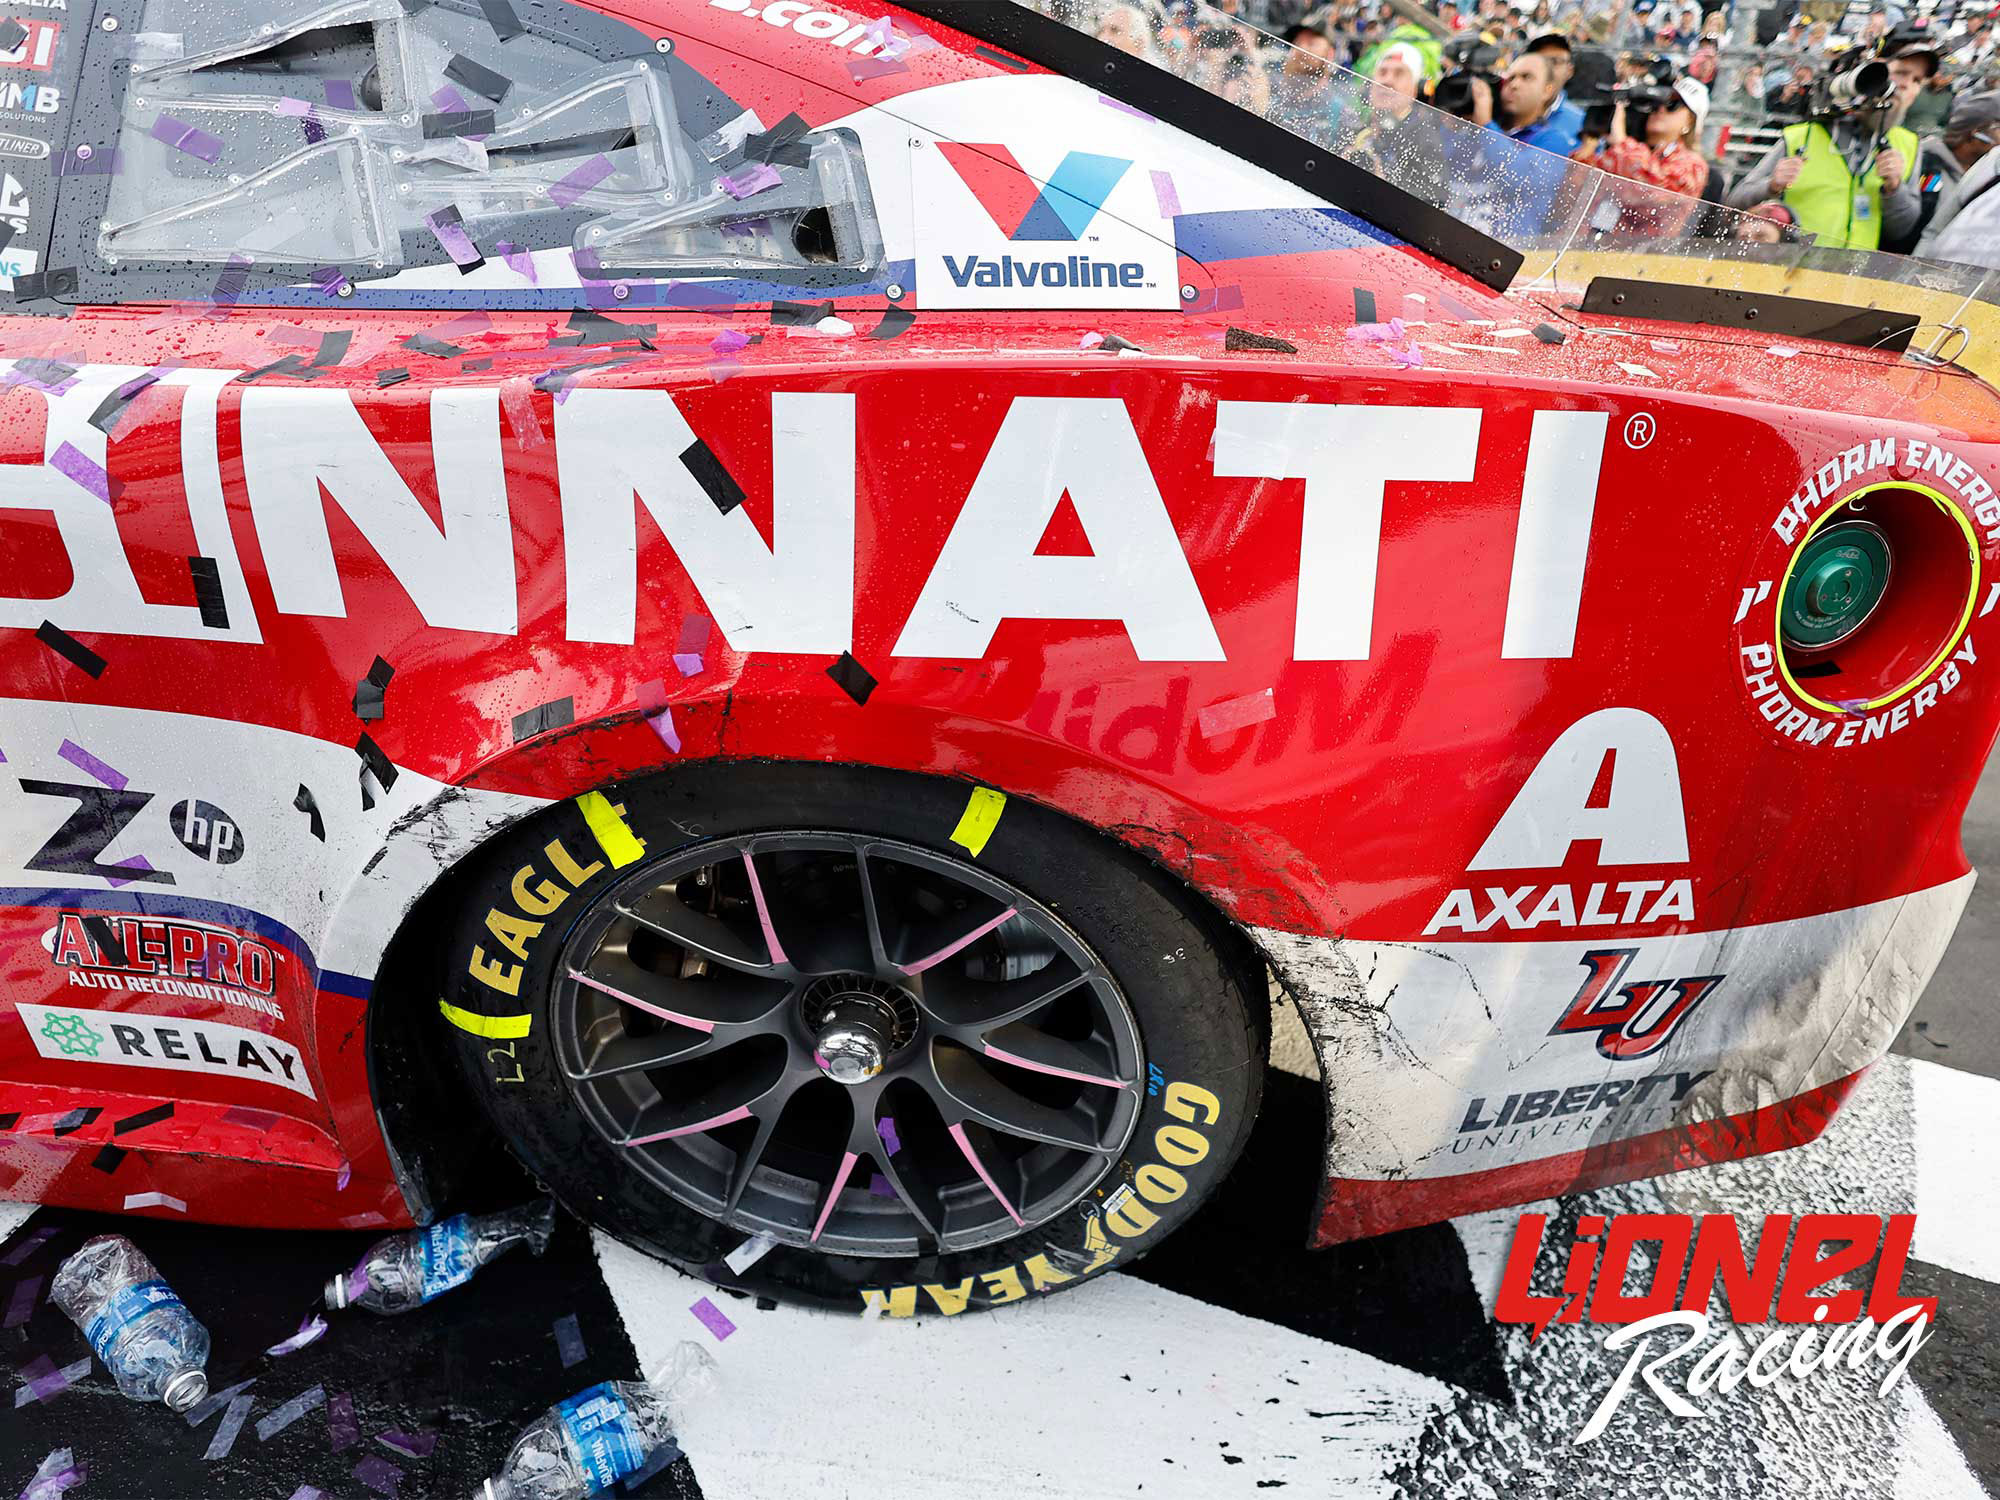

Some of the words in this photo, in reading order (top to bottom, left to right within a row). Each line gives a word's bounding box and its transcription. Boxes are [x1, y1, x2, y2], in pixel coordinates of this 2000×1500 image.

[942, 255, 1144, 287] Valvoline
[1772, 437, 1896, 546] PHORM
[1741, 641, 1837, 747] PHORM
[1834, 635, 1978, 748] ENERGY
[176, 799, 238, 865] hp
[468, 803, 647, 997] EAGL
[1421, 879, 1696, 936] AXALTA
[69, 970, 123, 991] AUTO
[124, 975, 285, 1021] RECONDITIONING
[110, 1023, 296, 1081] RELAY
[1452, 1105, 1687, 1155] UNIVERSITY
[1458, 1070, 1715, 1134] LIBERTY
